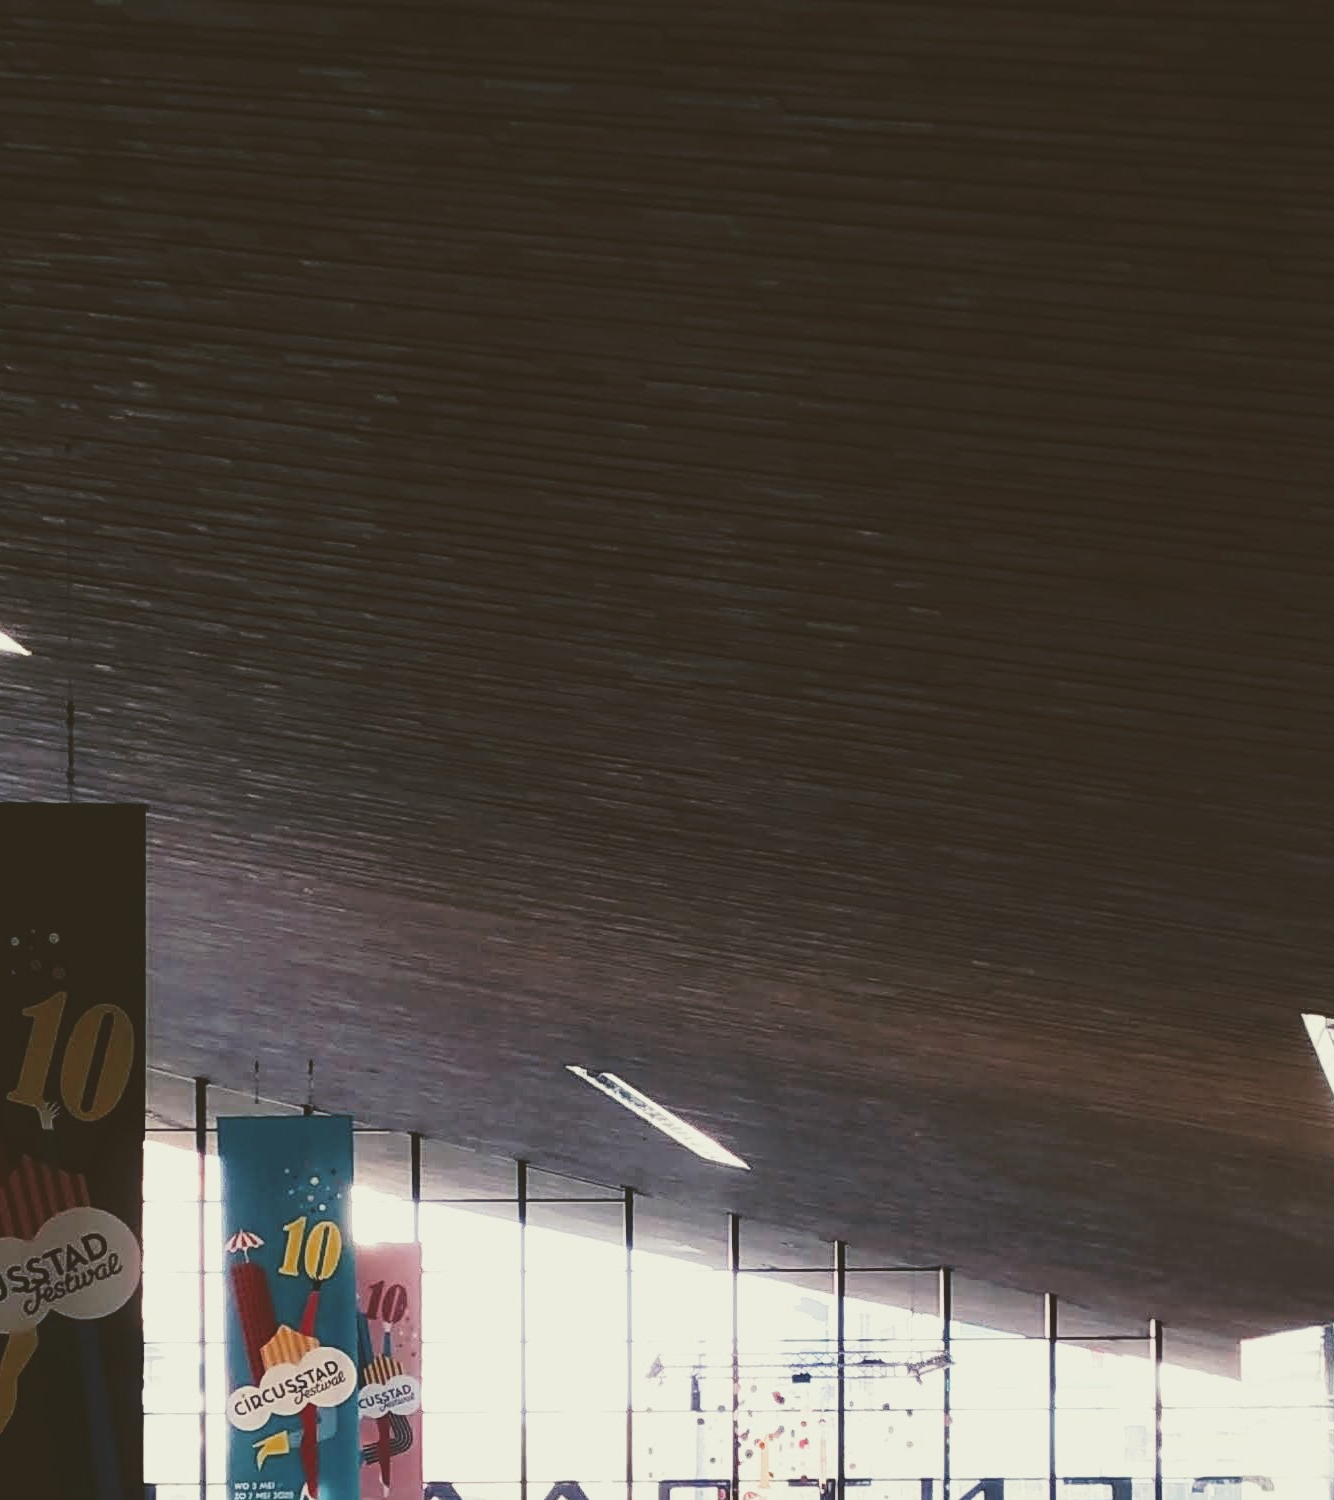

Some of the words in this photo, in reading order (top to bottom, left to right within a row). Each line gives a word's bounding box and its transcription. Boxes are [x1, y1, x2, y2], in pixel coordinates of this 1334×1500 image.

[6, 991, 135, 1122] 10
[278, 1216, 343, 1281] 10
[366, 1280, 408, 1324] 10
[358, 1384, 412, 1409] CUSSTAD
